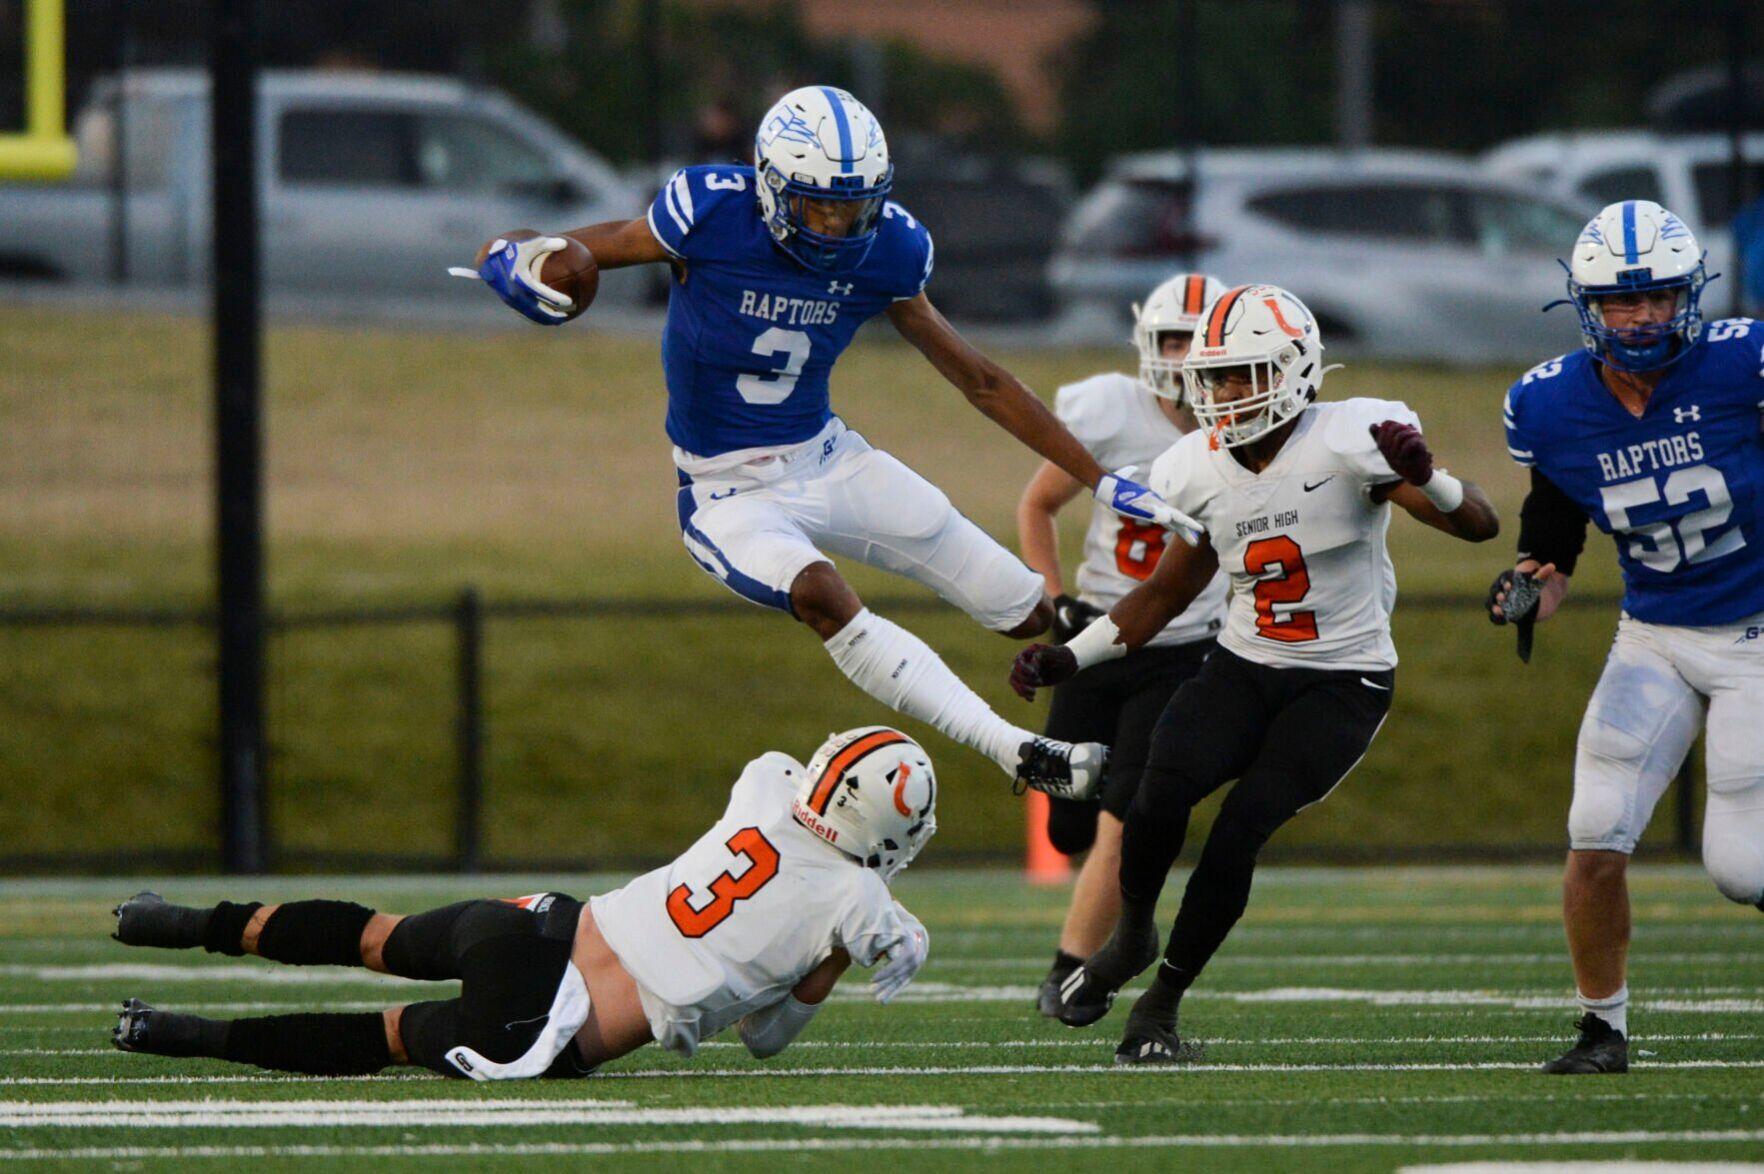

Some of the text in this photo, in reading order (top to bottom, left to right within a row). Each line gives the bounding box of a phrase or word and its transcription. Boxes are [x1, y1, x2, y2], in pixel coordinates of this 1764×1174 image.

[705, 173, 746, 191] 3
[739, 290, 840, 325] RAPTORS
[736, 327, 812, 404] 3
[1597, 431, 1704, 481] RAPTORS
[1236, 510, 1299, 537] SENIOR HIGH
[1599, 464, 1747, 573] 52
[1244, 535, 1319, 642] 2
[792, 799, 838, 842] Riddell
[666, 826, 781, 939] 3
